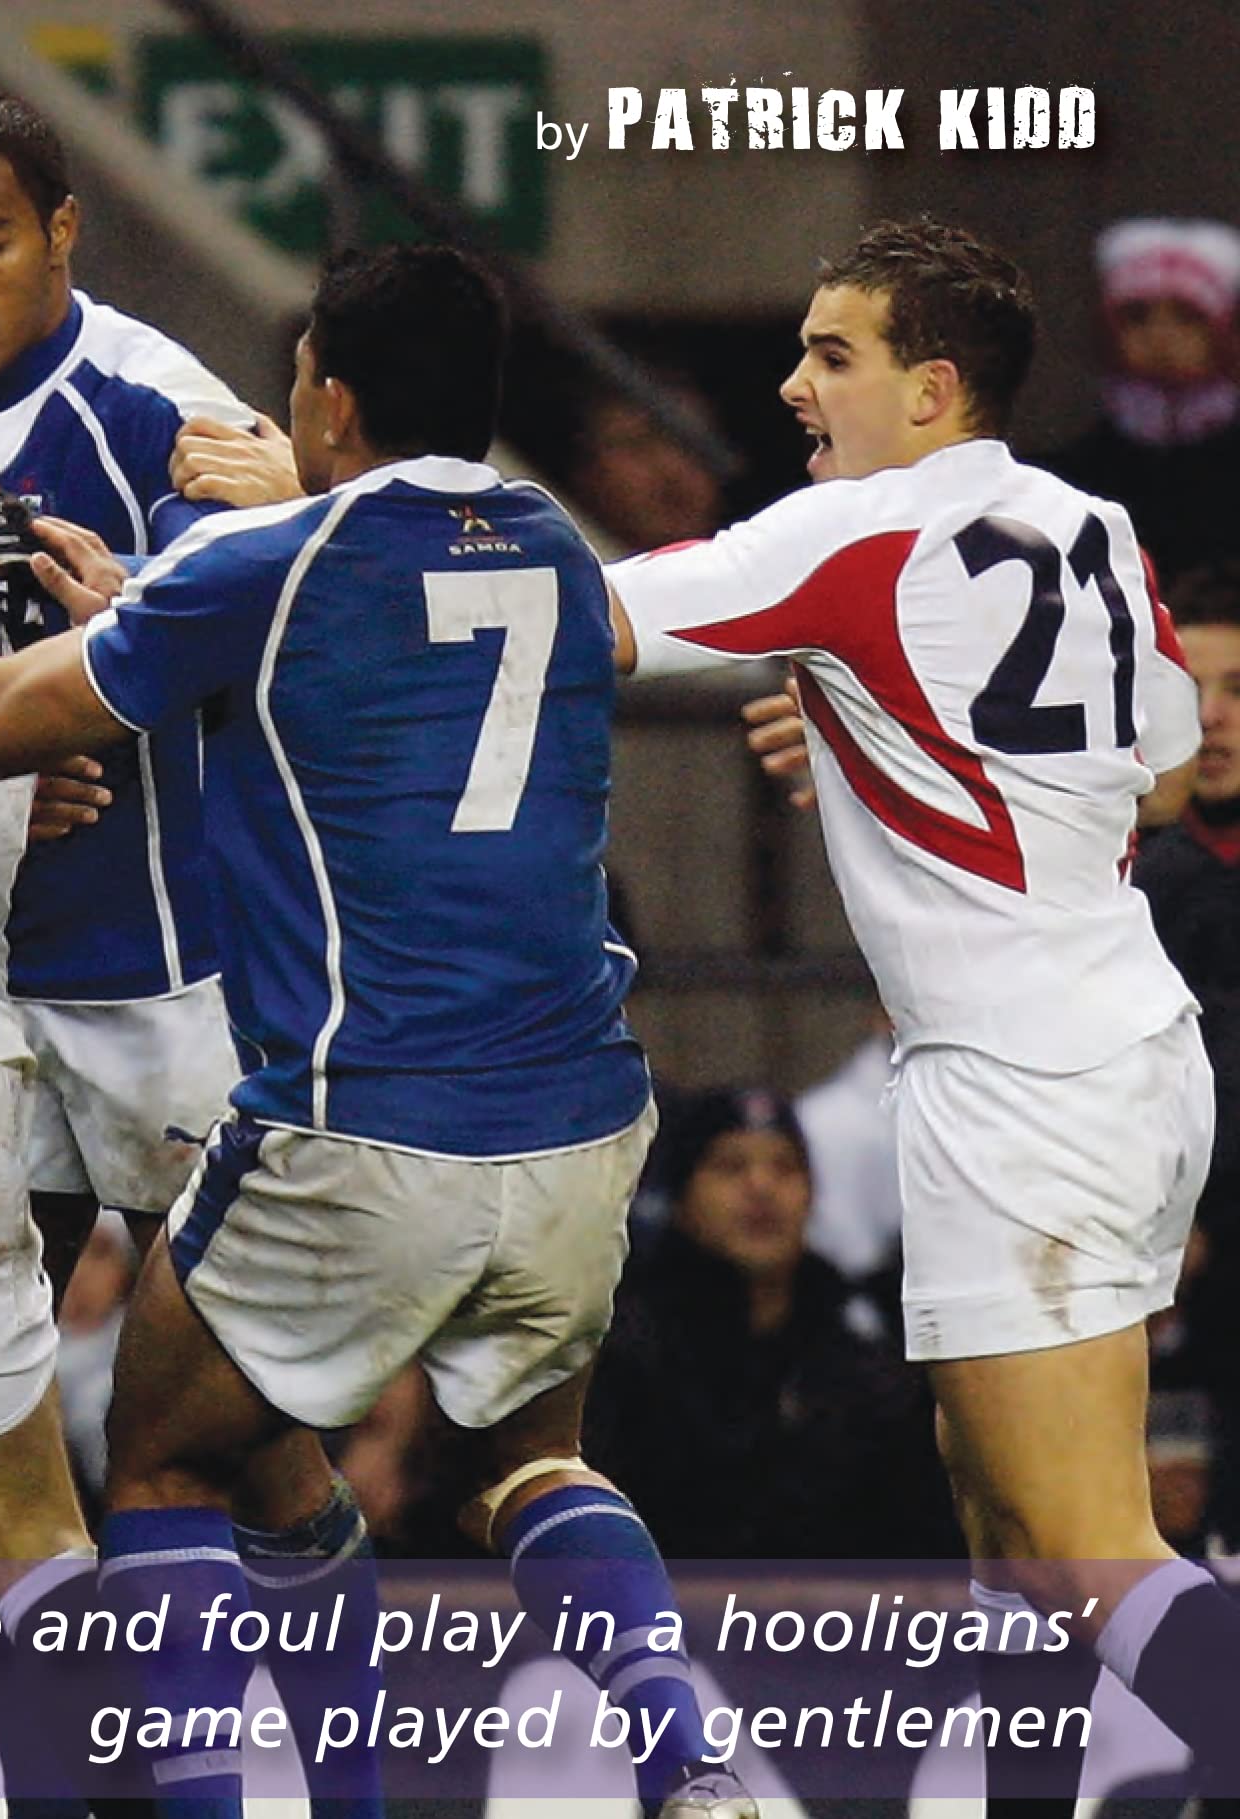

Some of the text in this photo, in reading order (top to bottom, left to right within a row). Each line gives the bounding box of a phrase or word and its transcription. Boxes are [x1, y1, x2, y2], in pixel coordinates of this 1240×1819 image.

[162, 84, 522, 207] EXIT
[448, 543, 522, 556] SAMOA
[951, 510, 1138, 757] 21
[422, 566, 559, 832] 7
